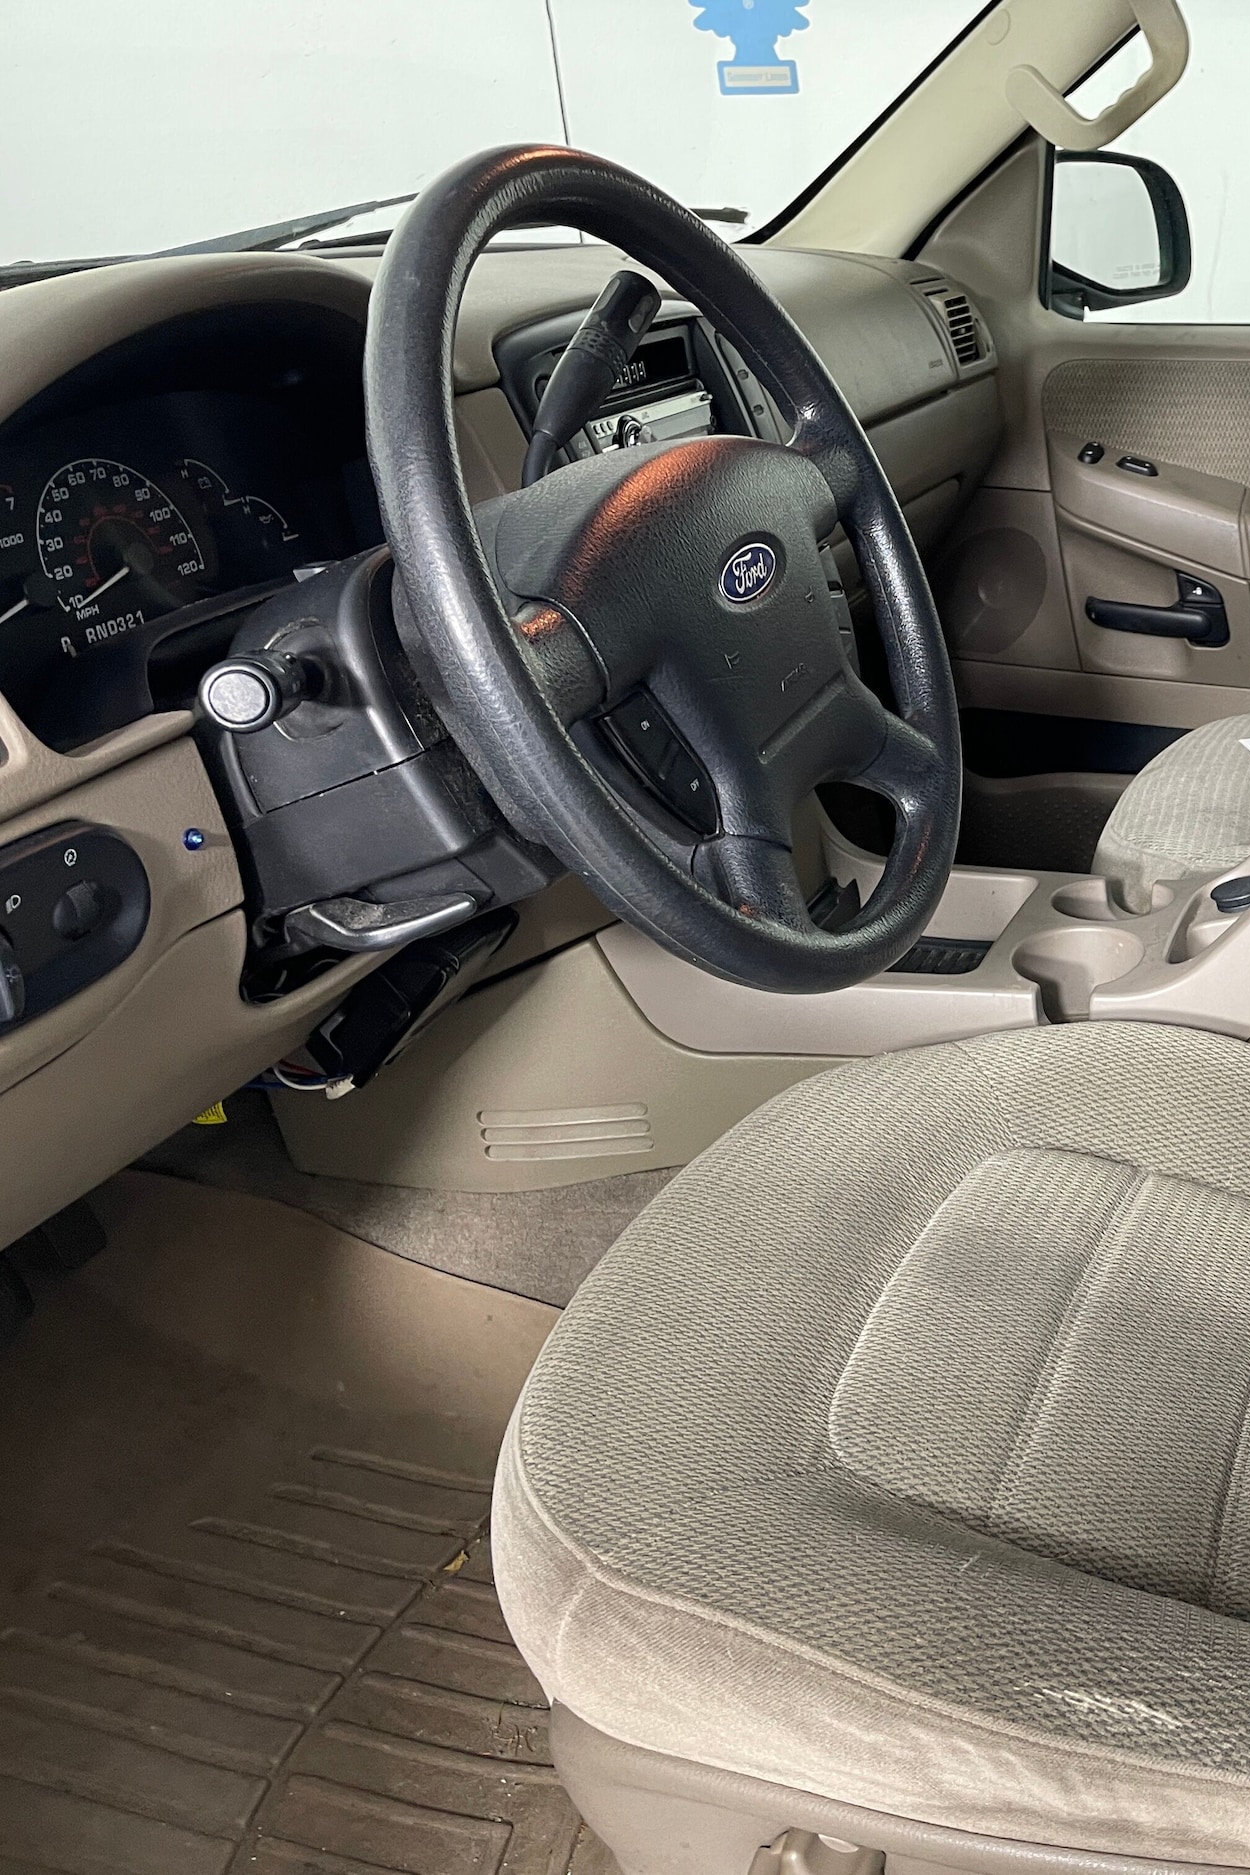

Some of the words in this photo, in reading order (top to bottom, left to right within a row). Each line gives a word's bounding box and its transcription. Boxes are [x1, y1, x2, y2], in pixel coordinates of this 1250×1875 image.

[68, 472, 86, 486] 60
[89, 467, 107, 481] 70
[112, 473, 130, 488] 80
[51, 487, 69, 502] 50
[134, 488, 150, 501] 90
[5, 497, 14, 511] 7
[44, 510, 63, 523] 40
[149, 507, 171, 523] 100
[45, 537, 64, 551] 30
[170, 532, 188, 546] 110
[54, 565, 73, 581] 20
[177, 560, 199, 576] 120
[732, 551, 767, 594] Ford
[76, 604, 100, 621] MPH
